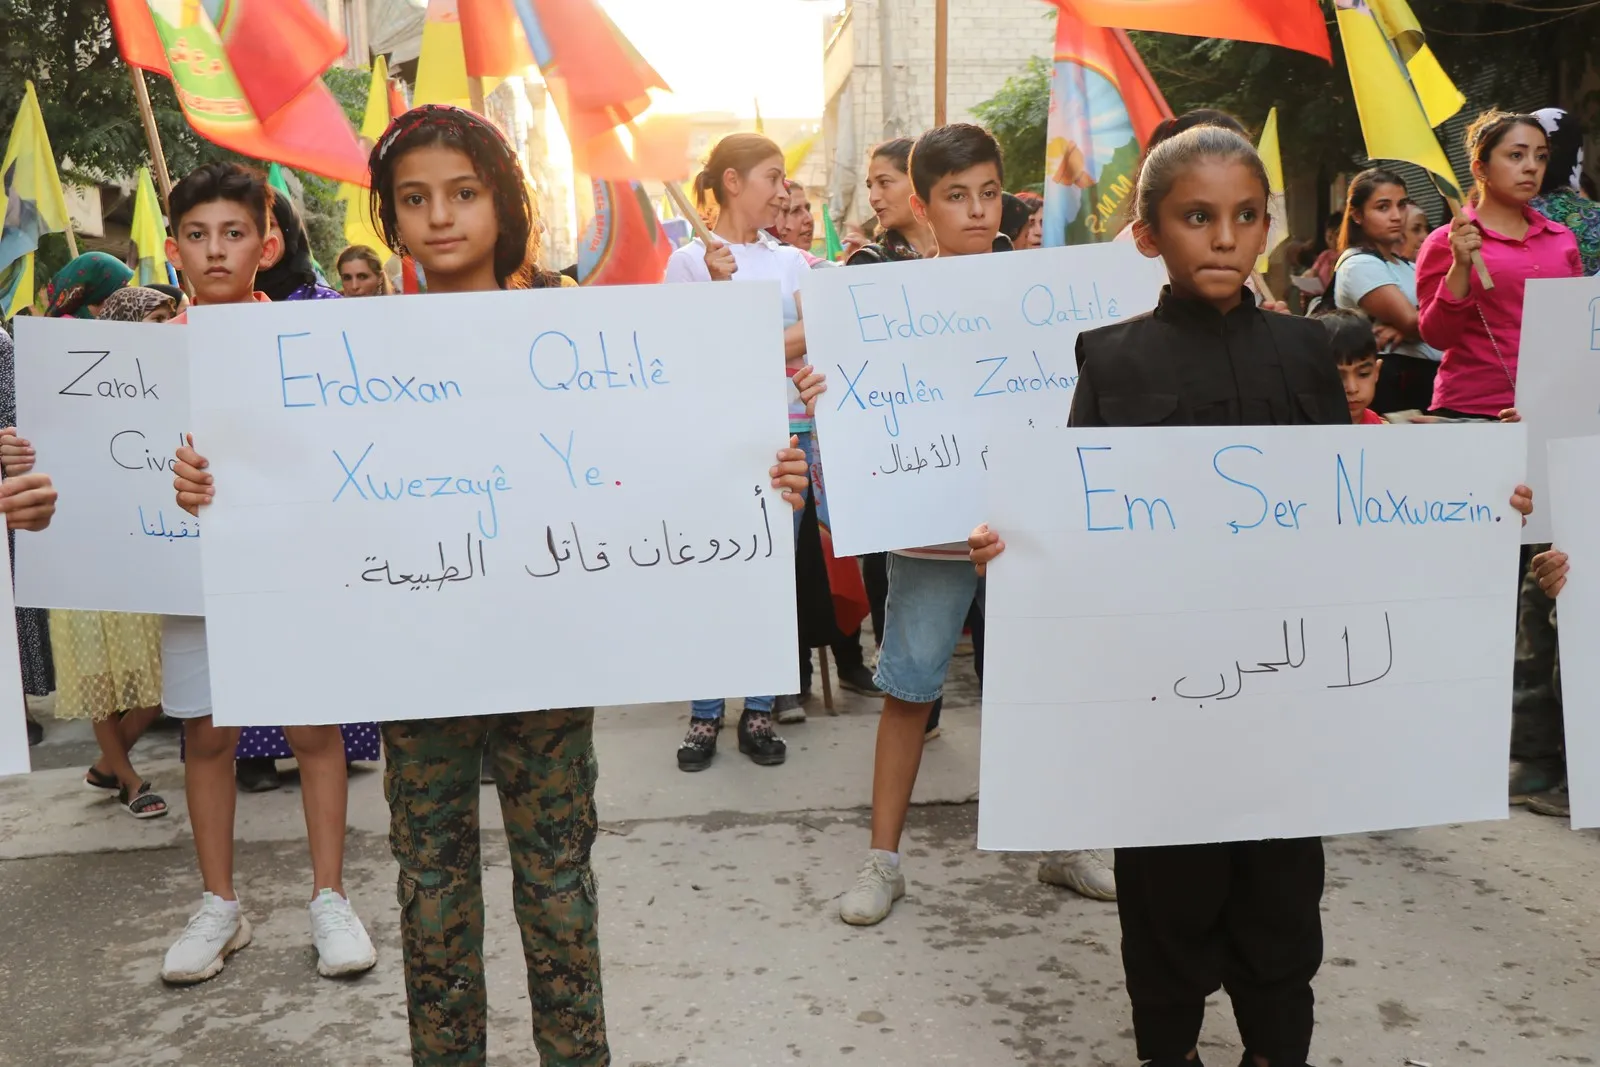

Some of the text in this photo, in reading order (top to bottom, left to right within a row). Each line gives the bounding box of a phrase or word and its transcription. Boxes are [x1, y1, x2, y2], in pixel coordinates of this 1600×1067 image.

[848, 281, 1123, 342] Erdoxan Qatilê
[59, 351, 160, 400] Zarok
[277, 331, 670, 408] Erdoxan Qatilê
[837, 360, 944, 437] Xeyalên
[333, 431, 622, 538] Xwezayê Ye.
[1076, 445, 1502, 533] Em Şer Naxwazin.
[525, 522, 611, 577] قاتل
[628, 485, 773, 567] أردوغان
[1327, 611, 1393, 688] لا
